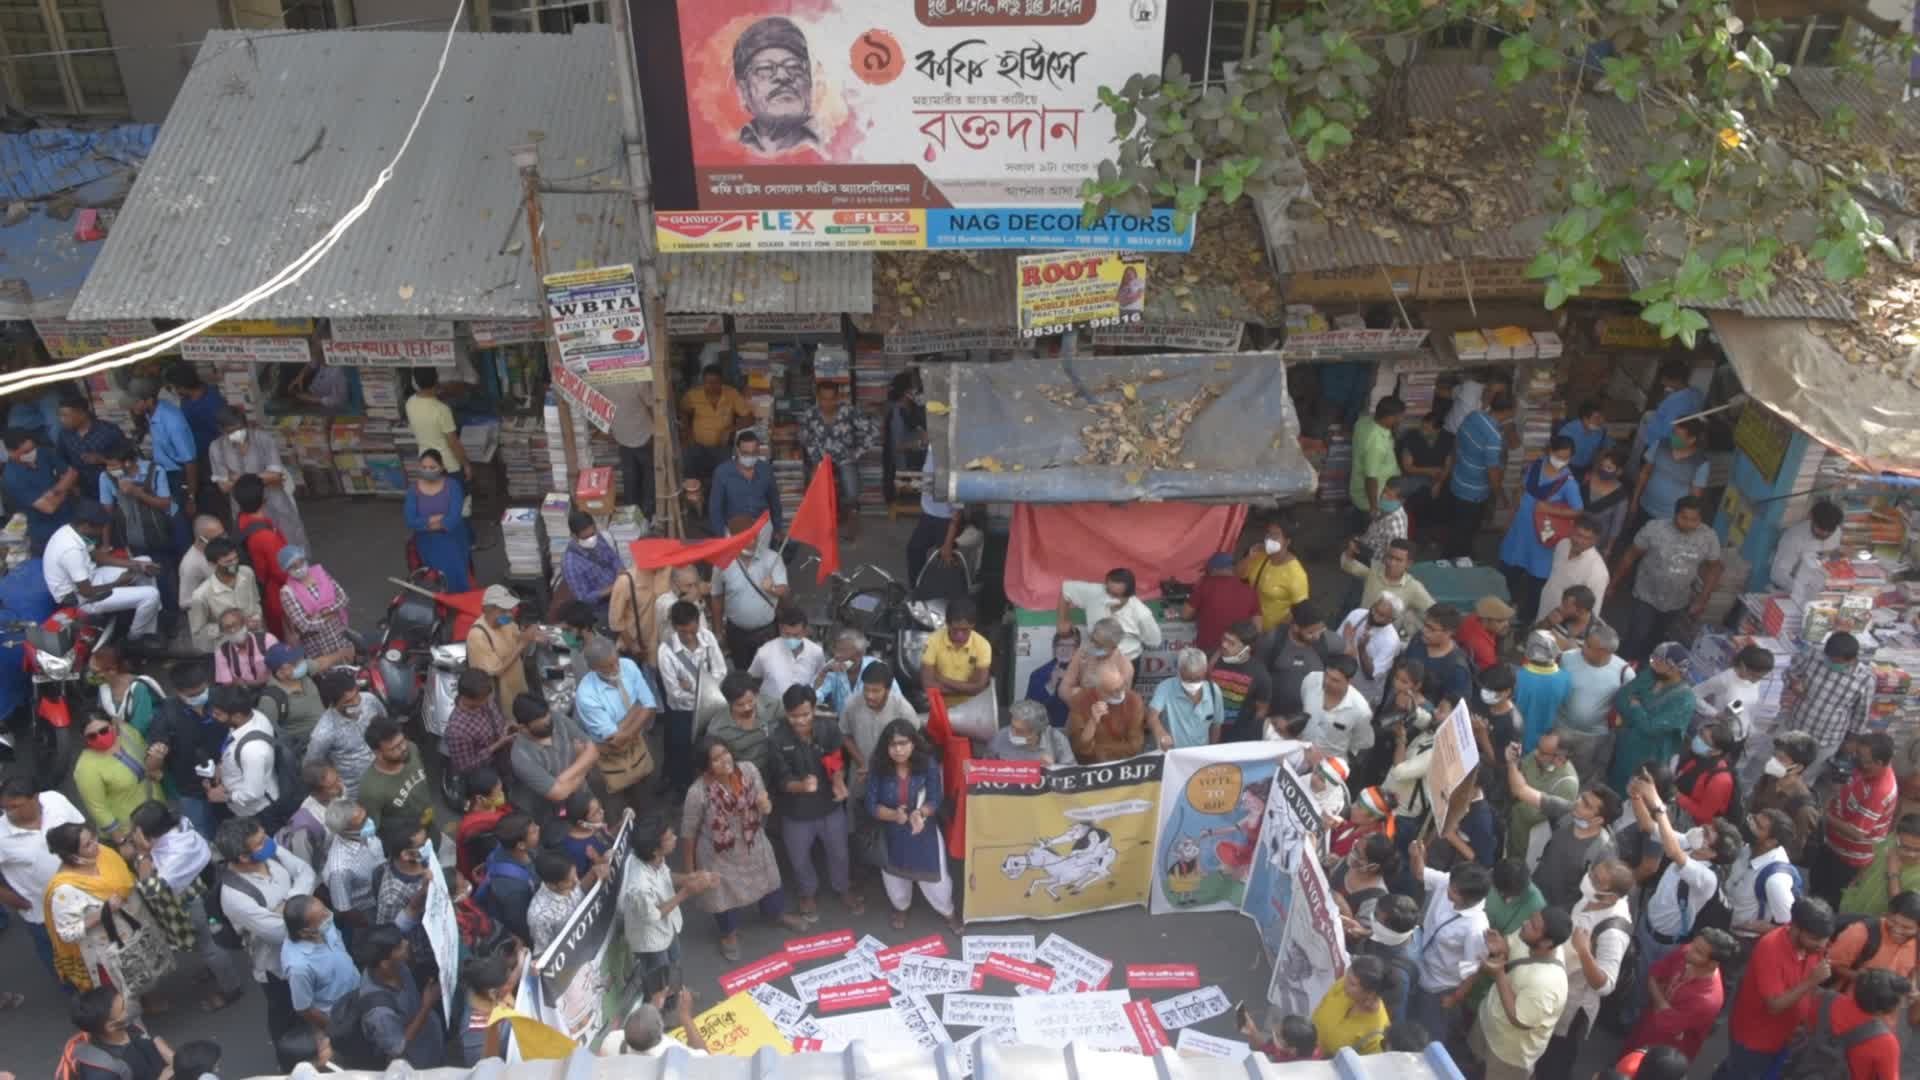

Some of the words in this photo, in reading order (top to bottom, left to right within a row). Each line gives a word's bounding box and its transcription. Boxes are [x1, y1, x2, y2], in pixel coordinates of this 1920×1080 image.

[912, 104, 1084, 162] রক্তদান
[746, 211, 815, 232] FLEX
[950, 214, 999, 231] NAG
[1021, 257, 1104, 288] ROOT
[555, 296, 636, 317] WBTA
[558, 319, 589, 332] TEST
[1022, 322, 1074, 339] 98301
[1082, 767, 1113, 786] TO
[1119, 763, 1157, 781] BJP
[919, 959, 951, 983] বিজেপি
[1174, 995, 1207, 1021] বিজেপি
